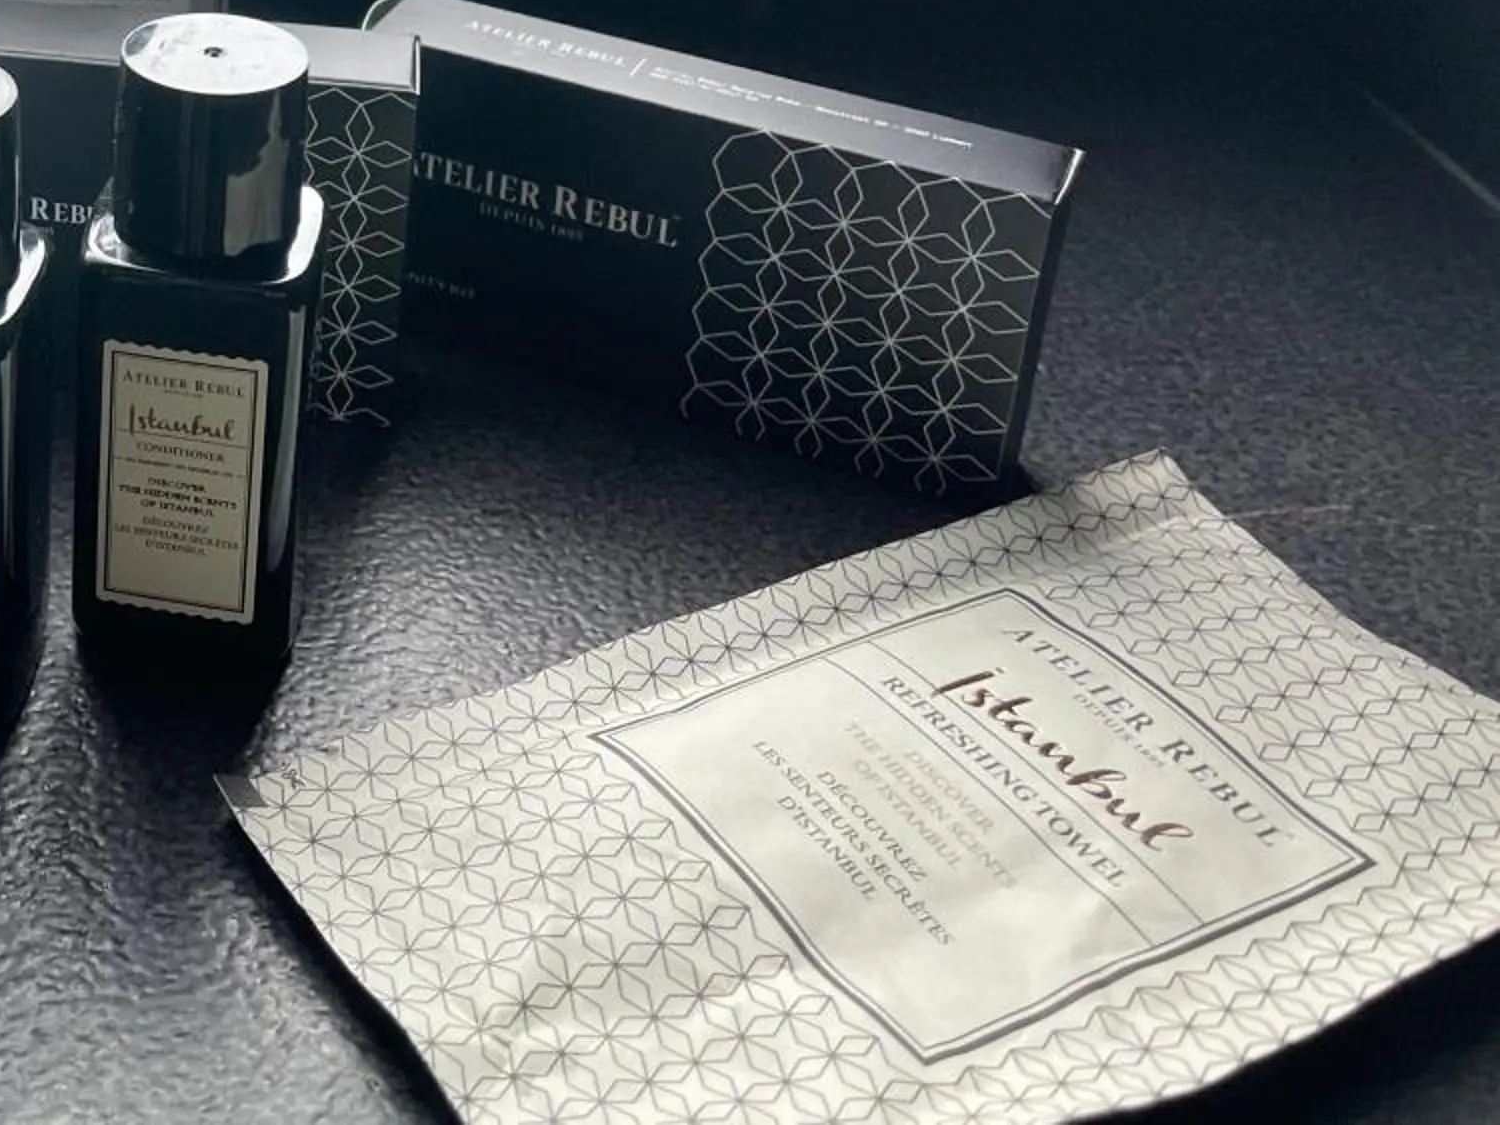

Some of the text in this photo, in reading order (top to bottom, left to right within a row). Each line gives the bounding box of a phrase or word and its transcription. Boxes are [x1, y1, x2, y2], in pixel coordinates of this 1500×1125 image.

[466, 20, 628, 69] ATELIER REBUL
[553, 184, 679, 248] REBUL
[123, 369, 187, 389] ATELIER
[195, 379, 244, 397] REBUL
[136, 440, 225, 463] CONDITIONER
[881, 676, 1129, 889] REFRESHING TOWEL
[902, 750, 995, 835] DISCOVER
[1003, 627, 1281, 850] ATELIER REBUL
[752, 740, 786, 768] LES
[781, 766, 870, 855] SENTEURS
[776, 794, 880, 901] D'ISTANBUL
[816, 770, 928, 883] DÉCOUVREZ
[844, 720, 1017, 889] THE HIDDEN SCENTS
[854, 758, 963, 870] OF ISTANBUL
